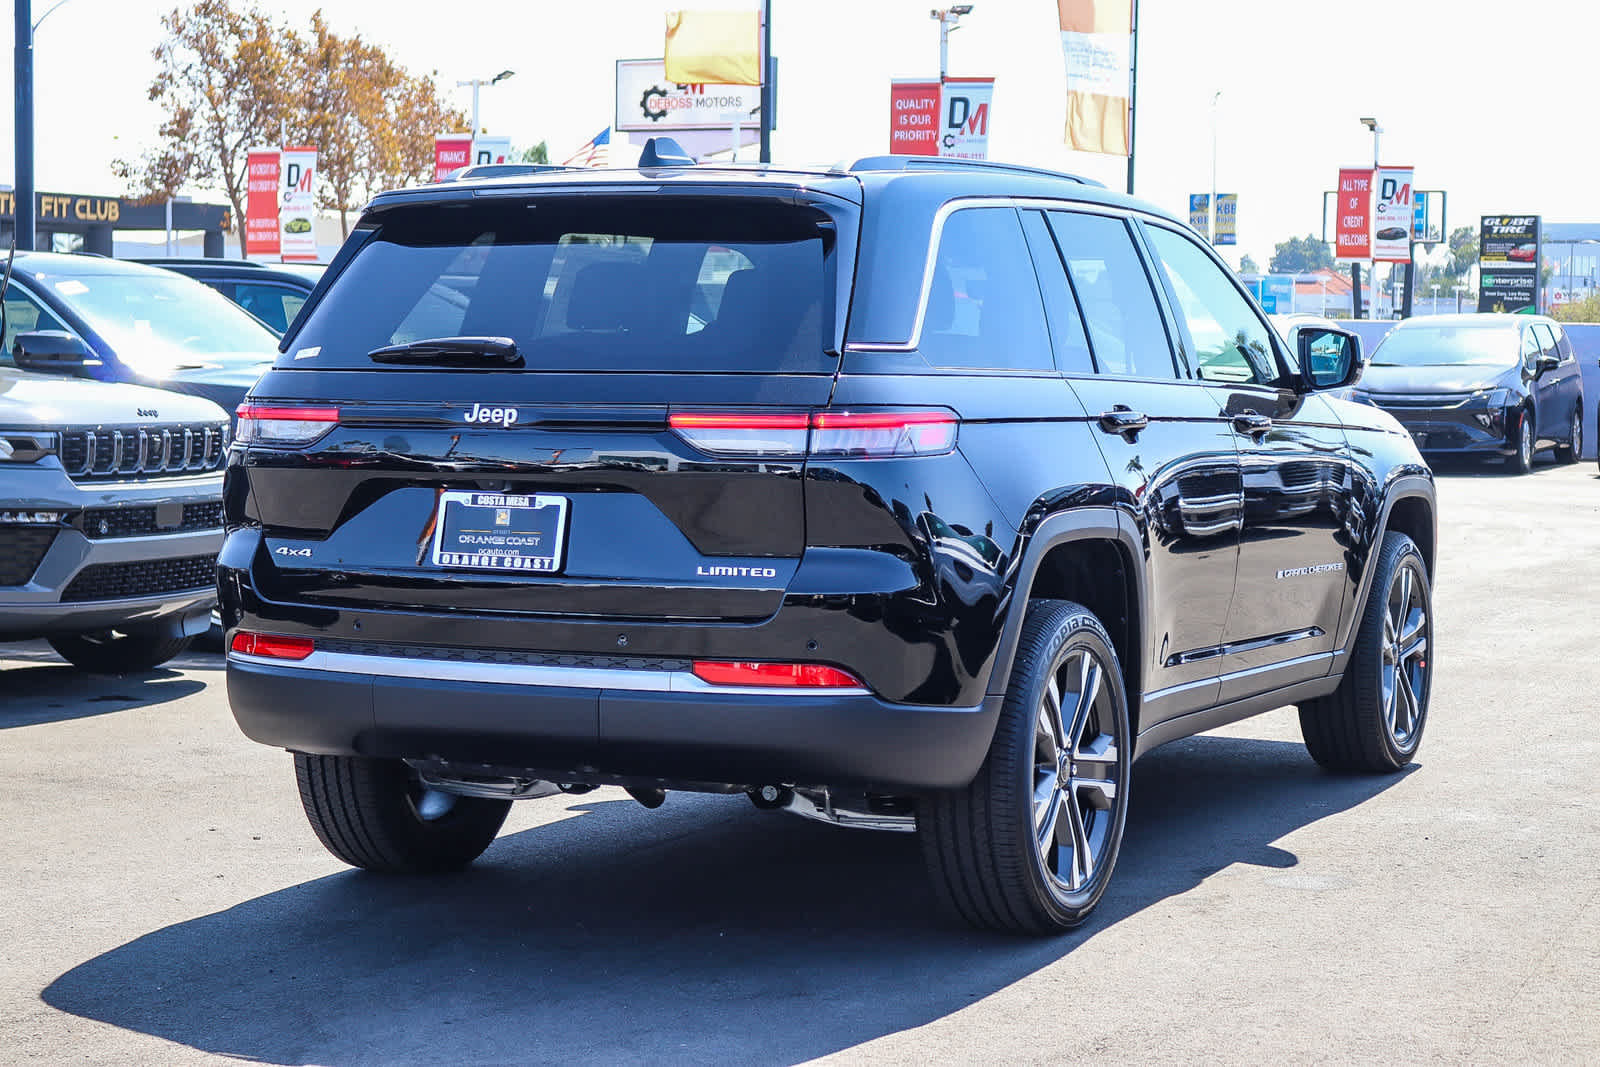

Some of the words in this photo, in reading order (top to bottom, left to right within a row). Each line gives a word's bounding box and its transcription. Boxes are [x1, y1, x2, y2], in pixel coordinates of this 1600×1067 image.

[695, 96, 743, 108] MOTORS
[895, 99, 936, 110] QUALITY
[899, 115, 908, 125] IS
[909, 114, 932, 125] OUR
[894, 129, 937, 141] PRIORITY
[439, 151, 466, 163] FINANCE
[1342, 179, 1353, 191] ALL
[1354, 179, 1368, 191] TYPE
[41, 196, 71, 218] FIT
[75, 198, 120, 222] CLUB
[1350, 198, 1358, 209] OF
[1343, 216, 1364, 228] CREDIT
[1492, 226, 1526, 234] TIRE
[1339, 234, 1369, 246] WELCOME
[1485, 277, 1534, 286] enterprise
[464, 403, 518, 427] Jeep
[478, 494, 505, 506] COSTA
[506, 496, 529, 507] MESA
[458, 535, 505, 546] ORANGE
[506, 536, 540, 546] COAST
[275, 546, 312, 557] 4x4
[478, 548, 520, 556] ocauto.com
[441, 554, 498, 567] ORANGE
[503, 556, 551, 569] COAST
[697, 566, 776, 577] LIMITED
